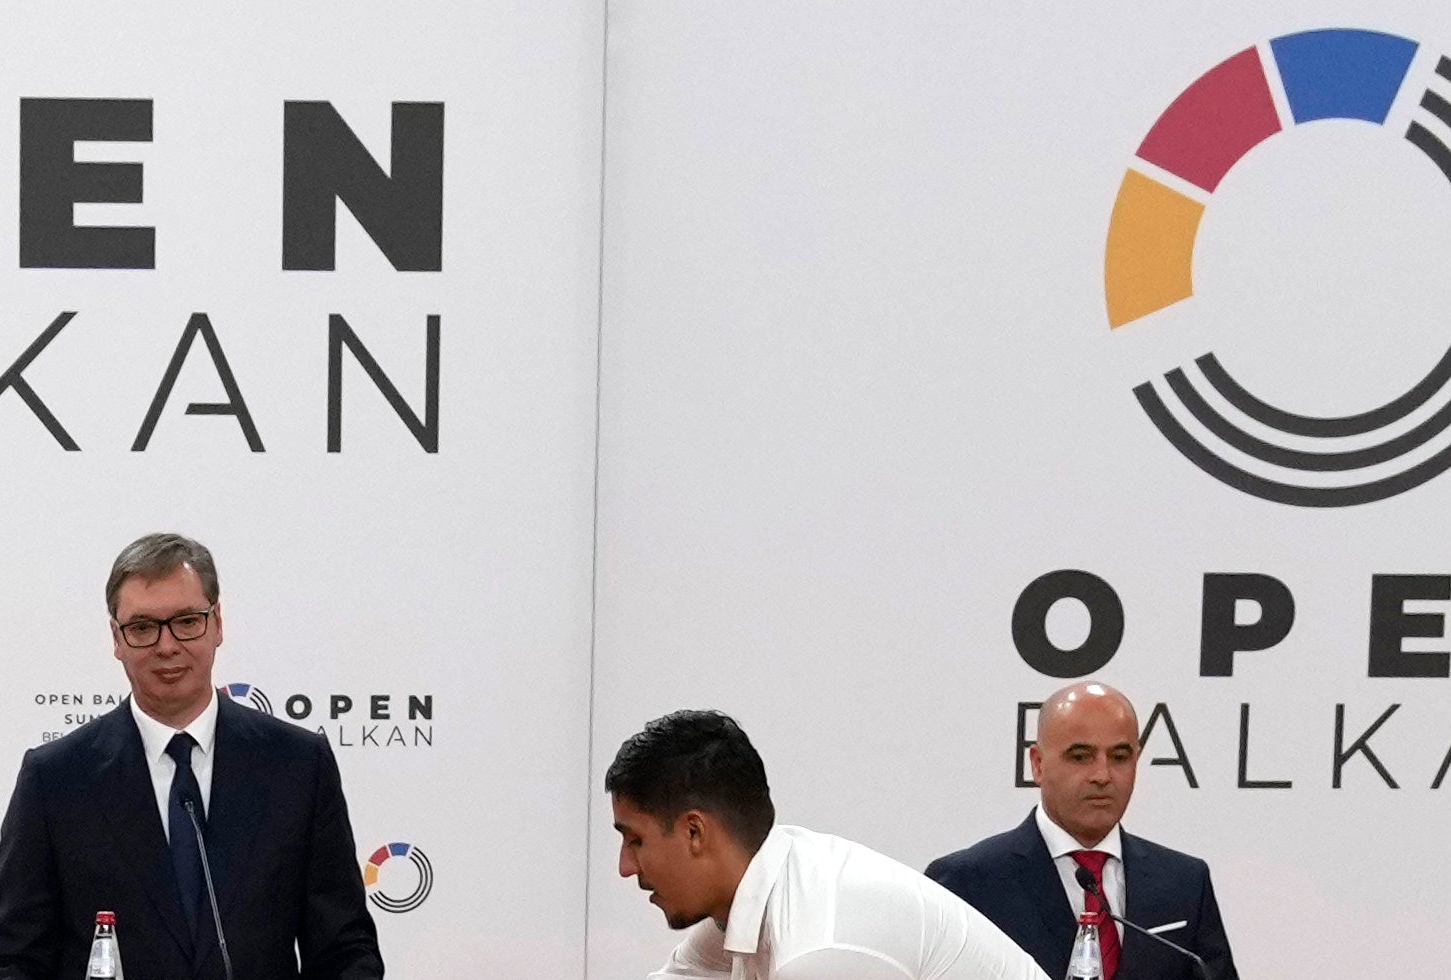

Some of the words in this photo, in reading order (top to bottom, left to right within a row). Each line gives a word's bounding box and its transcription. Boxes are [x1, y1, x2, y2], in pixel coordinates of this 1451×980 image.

[1011, 568, 1451, 679] OPE
[34, 694, 84, 705] OPEN
[285, 694, 433, 720] OPEN
[316, 725, 433, 747] LKAN
